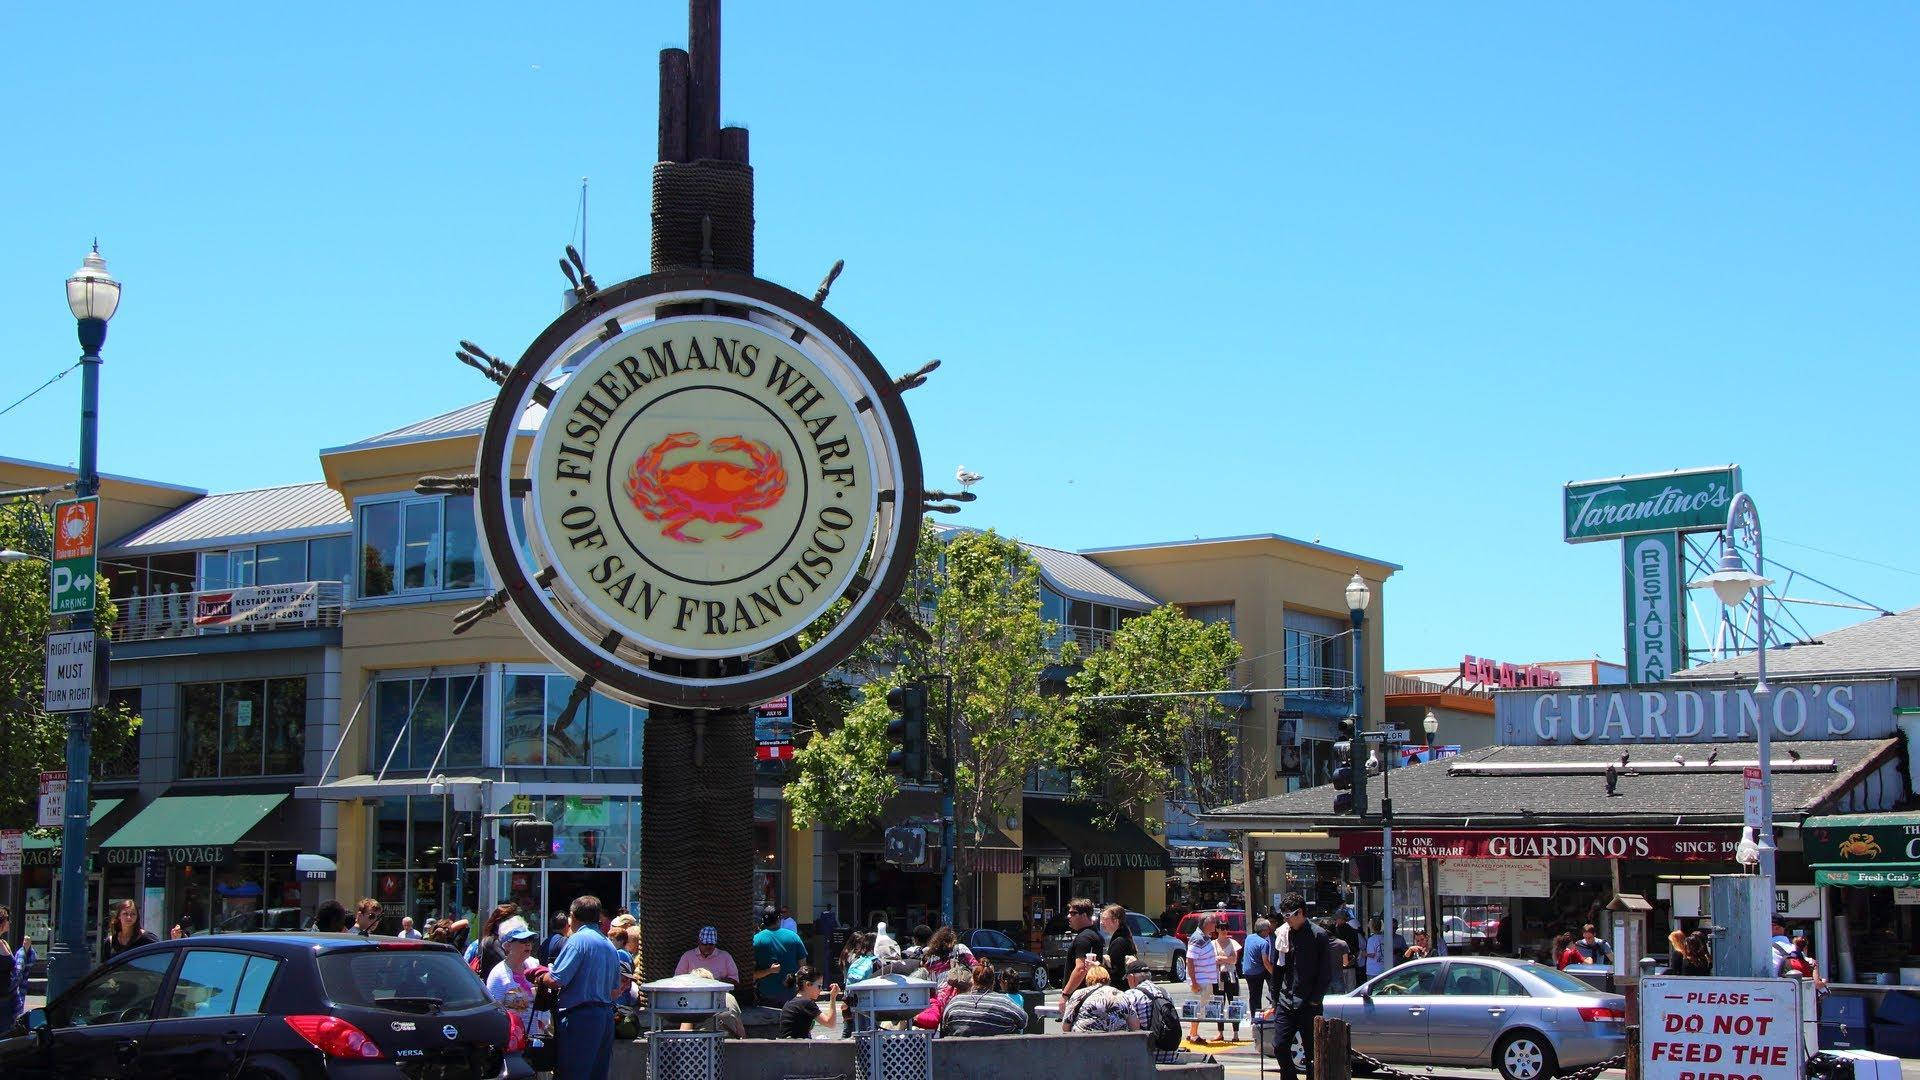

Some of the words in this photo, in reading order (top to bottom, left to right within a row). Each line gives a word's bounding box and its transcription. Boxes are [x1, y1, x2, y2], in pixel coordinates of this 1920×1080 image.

[556, 335, 760, 484] FISHERMANS
[765, 355, 856, 488] WHARF
[1569, 482, 1730, 535] Tarantino's
[560, 504, 608, 553] OF
[588, 554, 667, 622] SAN
[672, 505, 854, 636] FRANCISCO
[236, 596, 288, 606] RESTAURANT
[1641, 549, 1665, 683] RESTAURAN
[50, 643, 71, 656] RIGHT
[74, 640, 92, 654] LANE
[58, 664, 83, 680] MUST
[1465, 654, 1496, 686] EAT
[1500, 662, 1520, 688] AT
[48, 690, 67, 702] TURN
[70, 688, 90, 700] RIGHT
[1533, 684, 1856, 742] GUARDINO'S
[1371, 732, 1403, 741] TALOR
[48, 796, 60, 806] ANY
[46, 807, 62, 817] TIME
[1903, 826, 1920, 834] TH
[1412, 837, 1433, 846] ONE
[1488, 836, 1649, 857] GUARDINO'S
[1675, 841, 1716, 852] SINCE
[22, 852, 56, 865] YAGE
[168, 848, 224, 862] VOYAGE
[1430, 847, 1465, 856] WHARF
[1084, 853, 1121, 866] GOLDEN
[1125, 854, 1162, 867] VOYAGE
[306, 871, 327, 879] ATM
[1858, 873, 1884, 881] Fresh
[1886, 872, 1909, 882] Crab
[1686, 992, 1750, 1005] PLEASE
[1664, 1014, 1704, 1034] DO
[1713, 1015, 1774, 1036] NOT
[1651, 1042, 1722, 1062] FEED
[1732, 1045, 1788, 1066] THE
